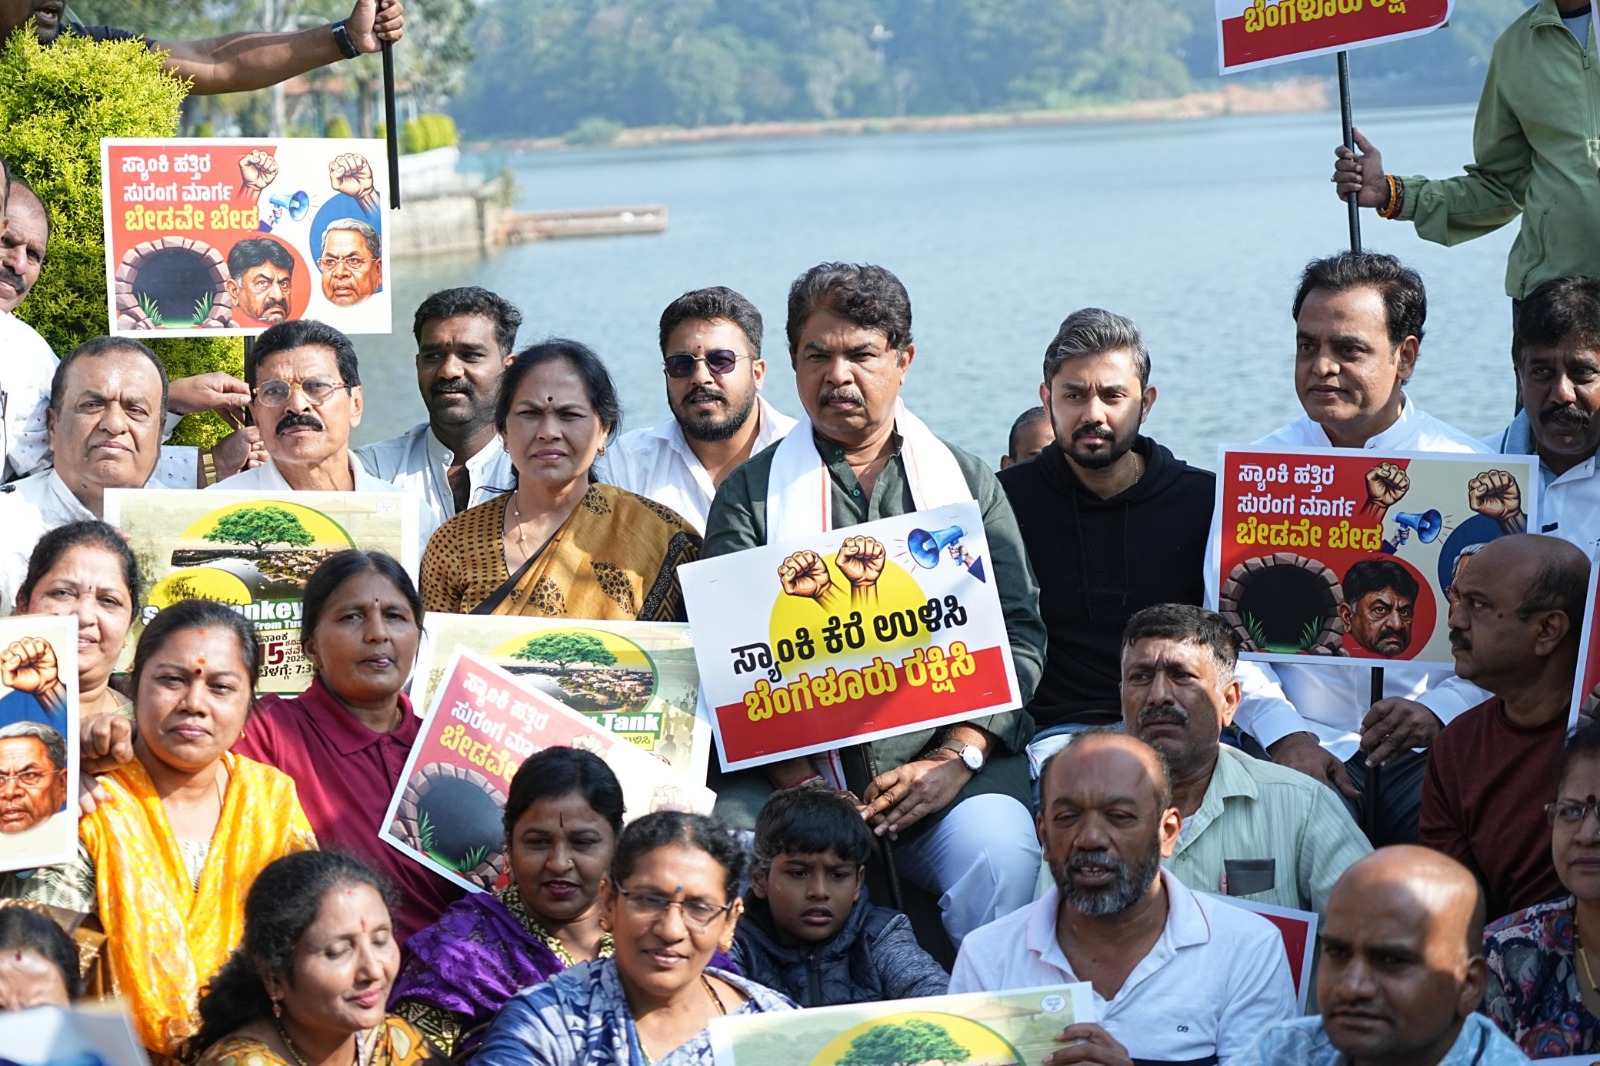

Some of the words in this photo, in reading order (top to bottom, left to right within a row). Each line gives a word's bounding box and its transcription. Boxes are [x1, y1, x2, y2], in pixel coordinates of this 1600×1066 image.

[122, 154, 169, 181] ಸ್ಯಾಂಕಿ
[174, 153, 211, 180] ಹತ್ತಿರ
[123, 182, 178, 202] ಸುರಂಗ
[182, 182, 233, 202] ಮಾರ್ಗ
[125, 203, 205, 231] ಬೇಡವೇ
[210, 203, 260, 230] ಬೇಡ
[1238, 463, 1289, 491] ಸ್ಯಾಂಕಿ
[1294, 463, 1335, 492] ಹತ್ತಿರ
[1237, 492, 1295, 515] ಸುರಂಗ
[1300, 495, 1356, 517] ಮಾರ್ಗ
[1236, 516, 1322, 547] ಬೇಡವೇ
[1328, 520, 1383, 550] ಬೇಡ
[730, 627, 815, 683] ಸ್ಯಾಂಕಿ
[821, 611, 866, 654] ಕೆರೆ
[873, 595, 968, 643] ಉಳಿಸಿ
[258, 642, 285, 666] 15
[743, 656, 897, 722] ಬೆಂಗಳೂರು
[902, 641, 976, 694] ರಕ್ಷಿಸಿ
[463, 672, 510, 710] ಸ್ಯಾಂಕಿ
[510, 699, 550, 734] ಹತ್ತಿರ
[451, 700, 507, 742] ಸುರಂಗ
[602, 713, 660, 732] Tank
